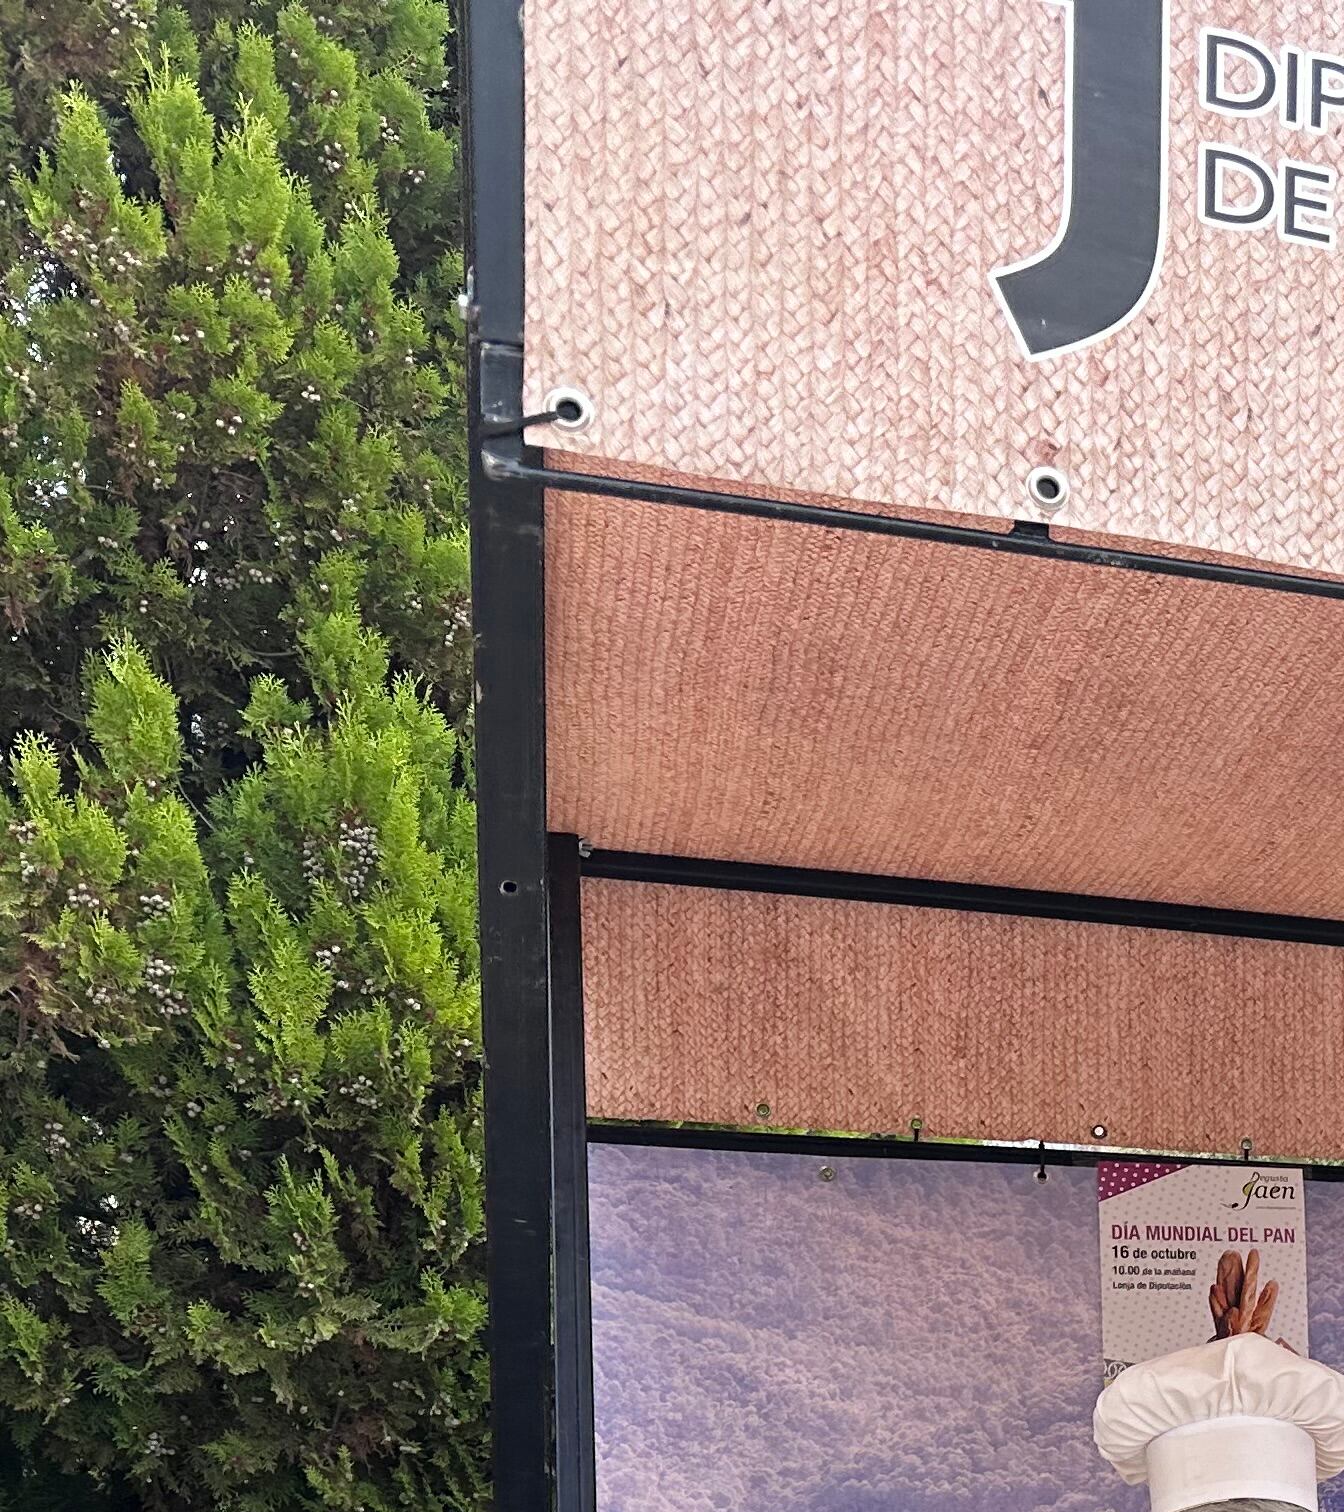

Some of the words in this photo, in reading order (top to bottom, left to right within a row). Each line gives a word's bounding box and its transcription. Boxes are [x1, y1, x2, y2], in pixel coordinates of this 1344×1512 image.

[1204, 151, 1328, 241] DE
[1111, 1221, 1140, 1241] DÍA
[1146, 1226, 1222, 1242] MUNDIAL
[1228, 1227, 1258, 1243] DEL
[1264, 1228, 1295, 1243] PAN
[1112, 1245, 1129, 1259] 16
[1132, 1247, 1147, 1259] de
[1151, 1248, 1197, 1260] octubre
[1112, 1265, 1140, 1275] 10.00
